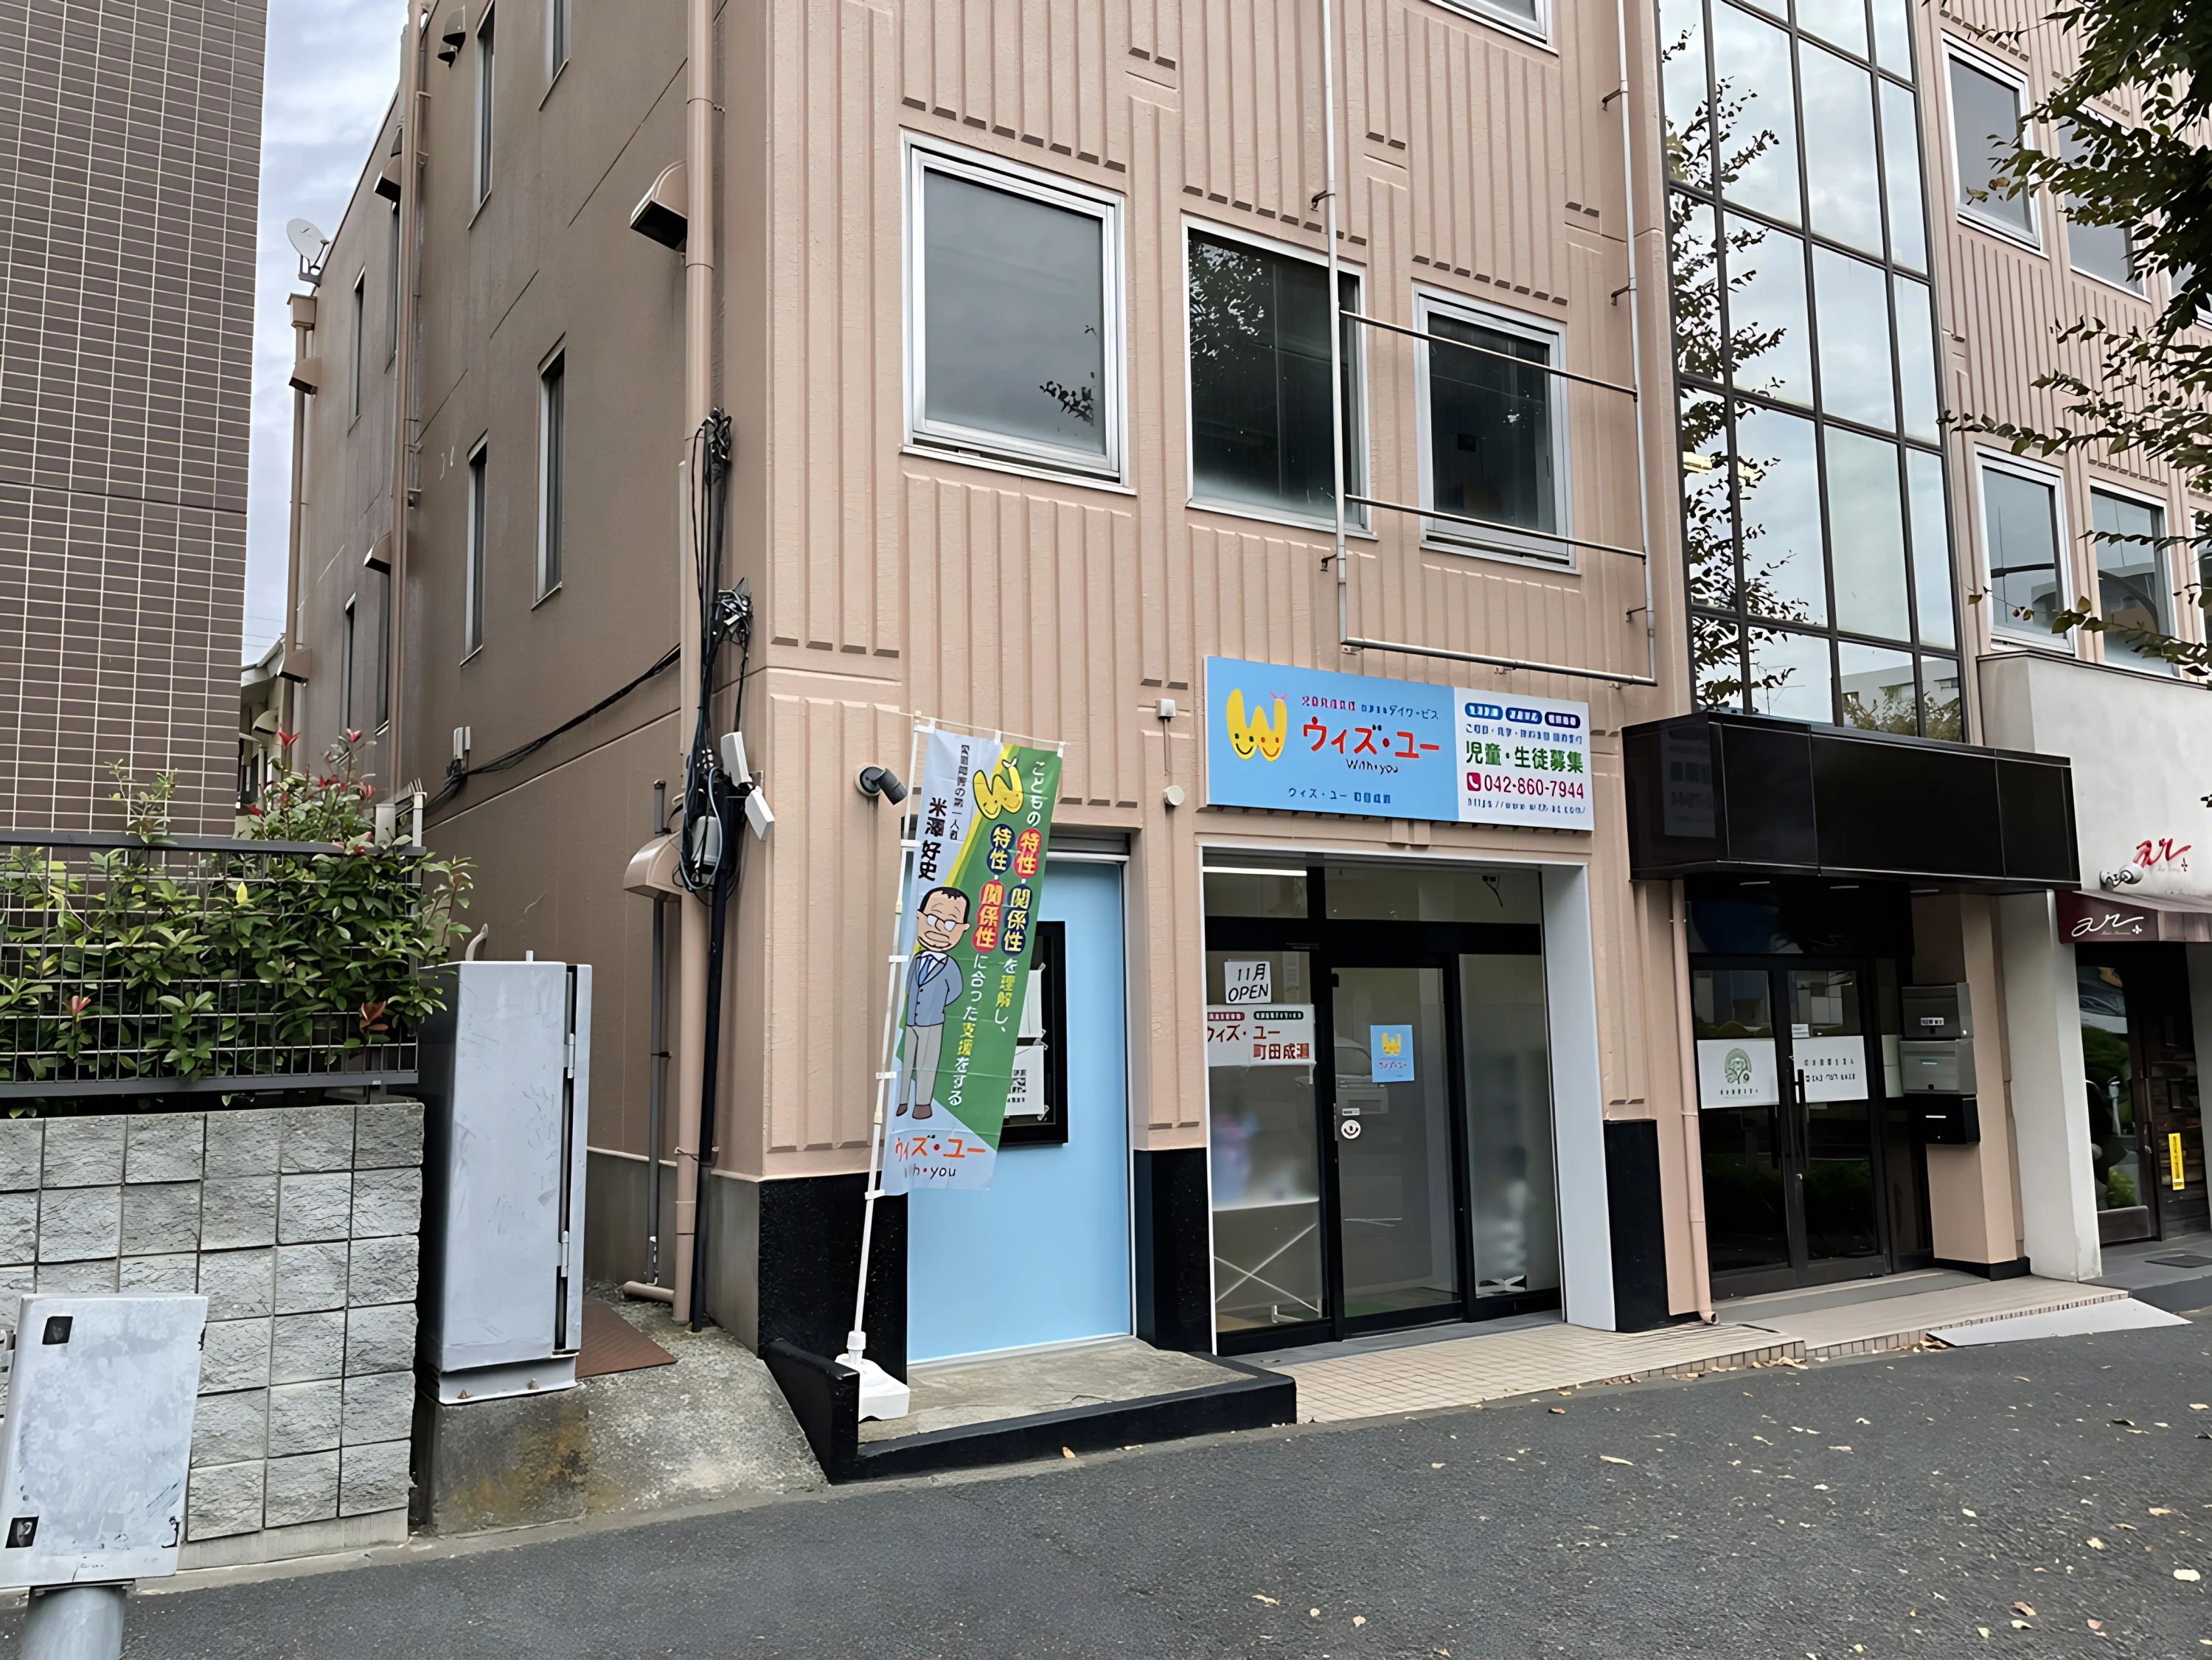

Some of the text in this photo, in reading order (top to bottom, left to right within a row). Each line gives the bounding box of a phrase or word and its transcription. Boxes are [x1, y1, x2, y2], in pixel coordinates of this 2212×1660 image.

[1304, 716, 1439, 759] ウィズ・ユー
[1484, 774, 1584, 799] 042-860-7944
[1238, 963, 1266, 982] 11月
[1228, 983, 1269, 1002] OPEN
